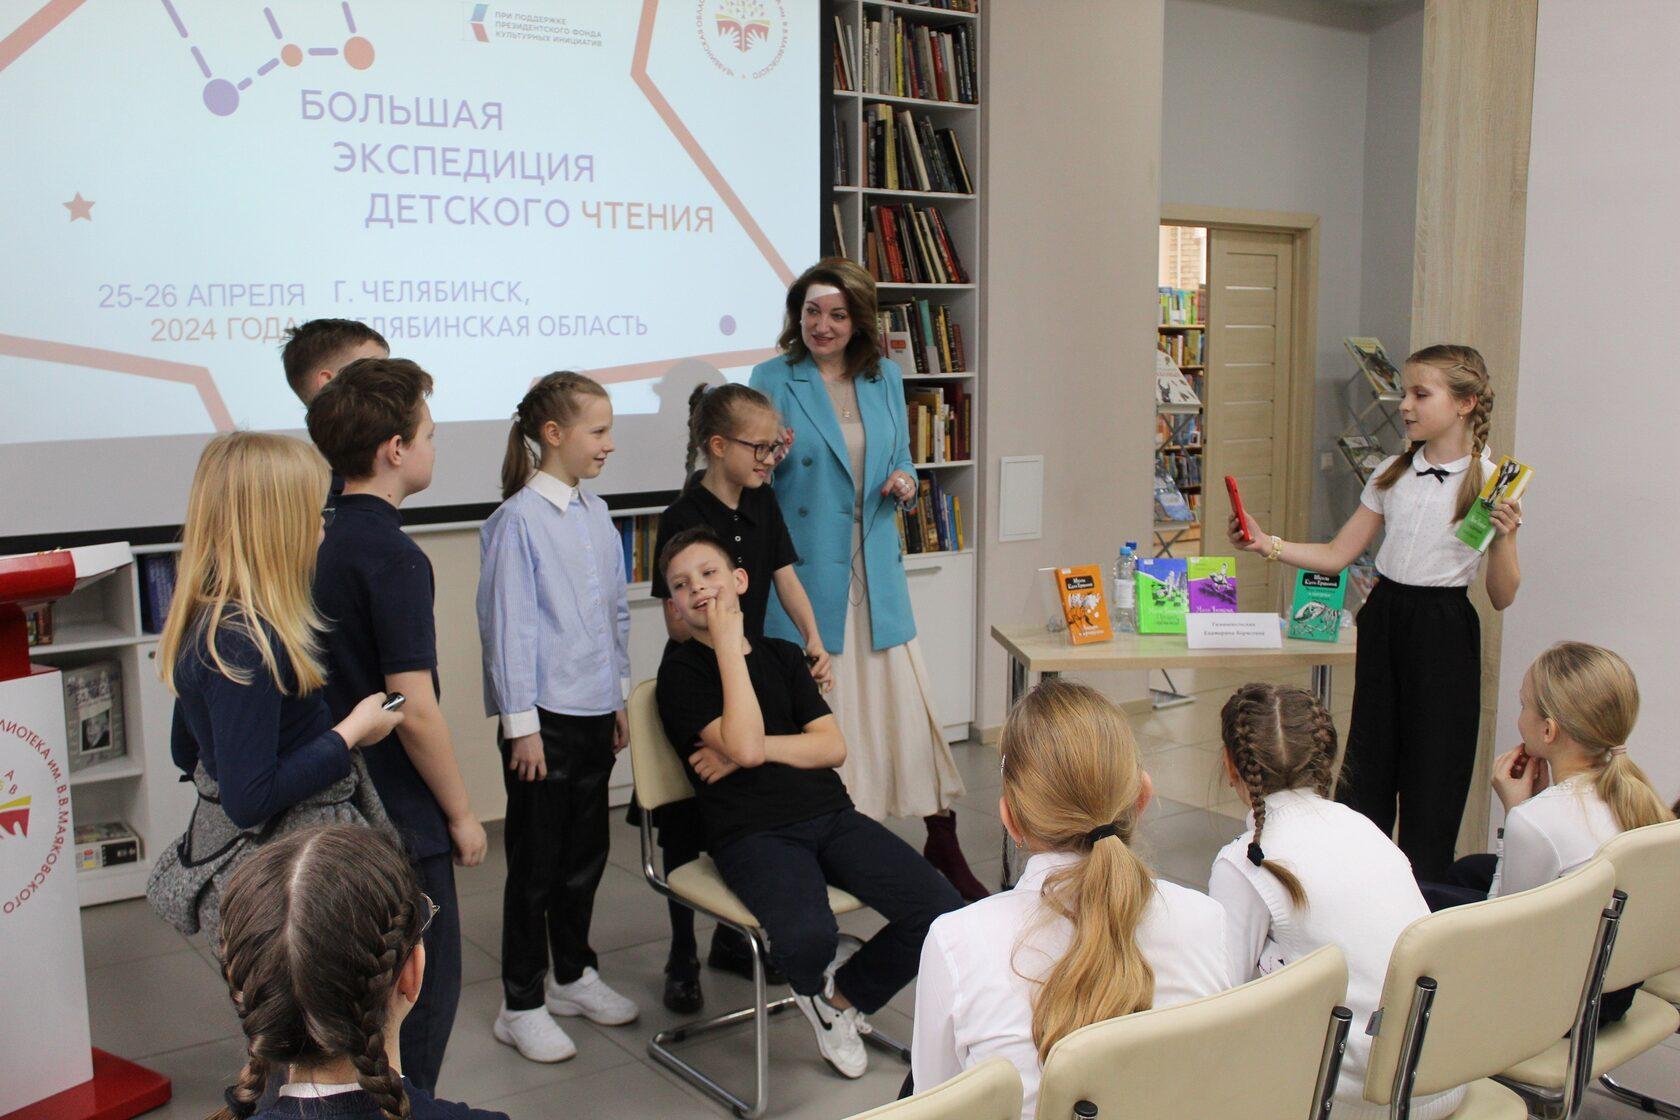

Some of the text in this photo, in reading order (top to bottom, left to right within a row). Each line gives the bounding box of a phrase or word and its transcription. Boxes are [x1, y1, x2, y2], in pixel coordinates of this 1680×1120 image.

[495, 11, 567, 25] ПРИ ПОДДЕРЖКЕ
[495, 21, 602, 38] ПРЕЗИДЕНТСКОГО ФОНДА
[495, 31, 602, 47] КУЛЬТУРНЫХ ИНИЦИАТИВ
[300, 88, 504, 131] БОЛЬШАЯ
[332, 141, 595, 186] ЭКСПЕДИЦИЯ
[364, 192, 714, 233] ДЕТСКОГО ЧТЕНИЯ
[98, 283, 306, 309] 25-26 АПРЕЛЯ
[334, 280, 530, 306] Г. ЧЕЛЯБИНСК,
[151, 318, 217, 342] 2024
[537, 314, 649, 338] ОБЛАСТЬ
